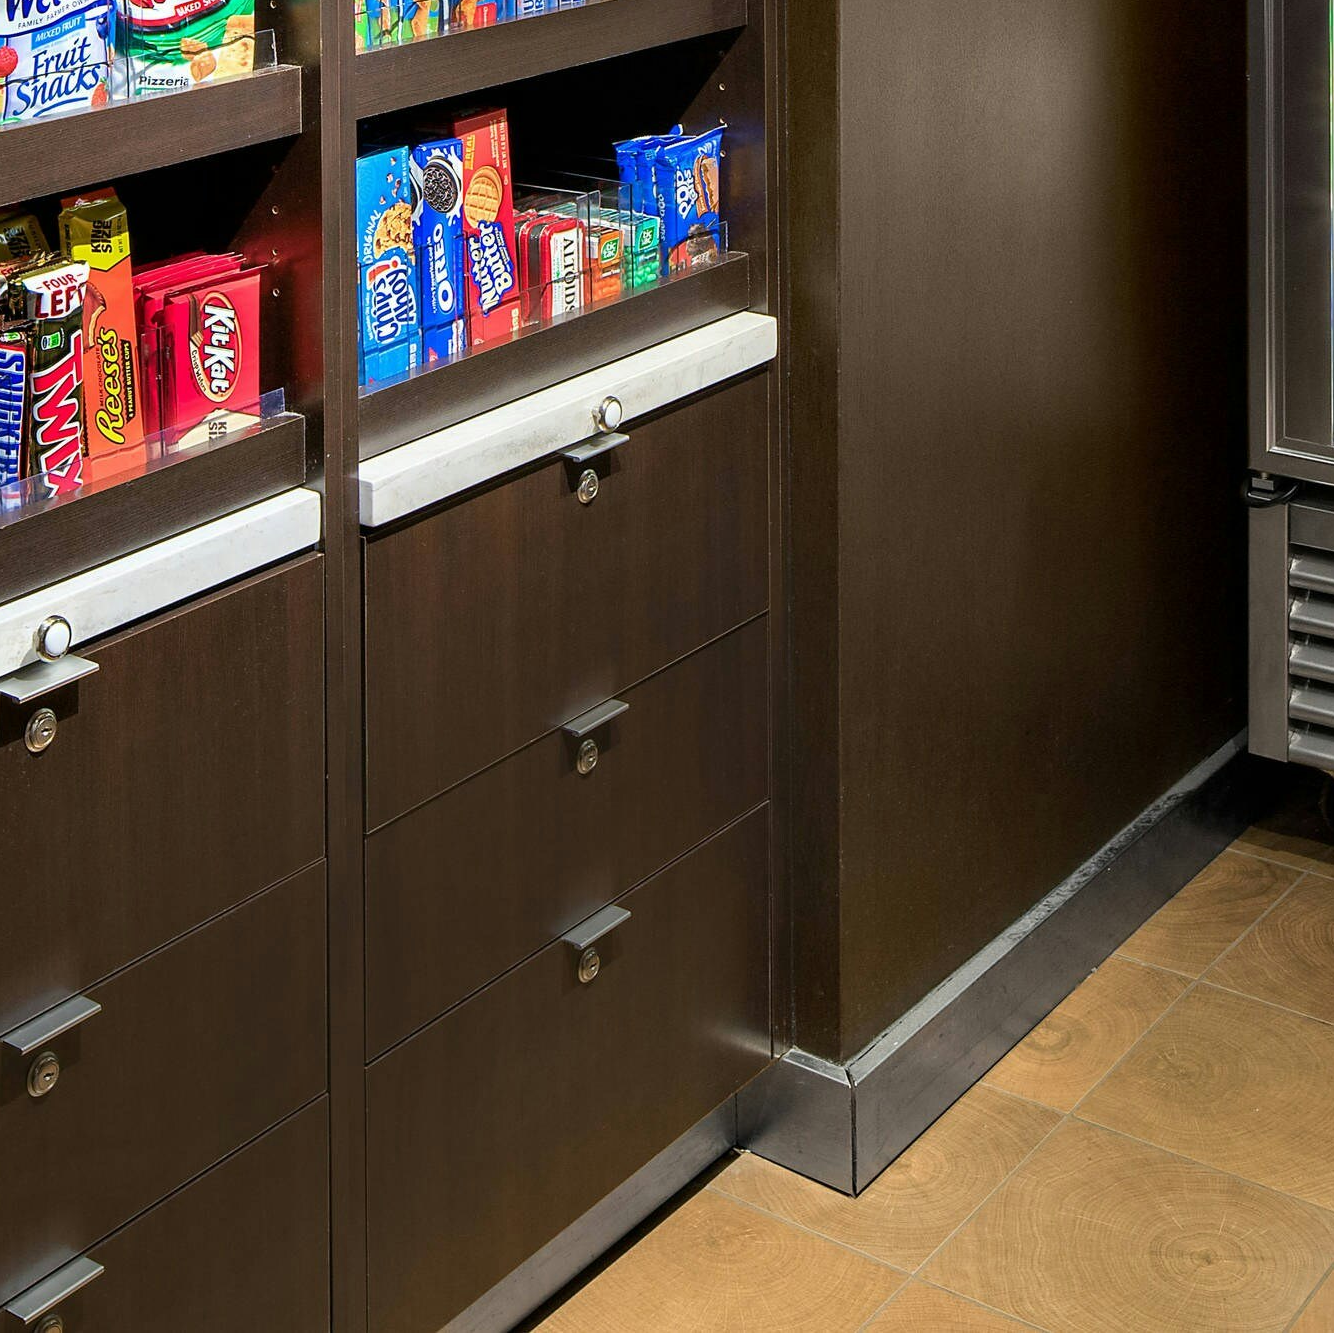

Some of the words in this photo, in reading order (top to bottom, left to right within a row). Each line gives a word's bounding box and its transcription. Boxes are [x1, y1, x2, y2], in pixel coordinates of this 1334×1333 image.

[17, 17, 44, 31] FAMILY
[35, 26, 61, 43] MIXED
[32, 36, 91, 79] Fruit
[13, 62, 100, 117] Snacks
[138, 75, 189, 87] Pizzeria
[101, 219, 113, 254] SIZE
[362, 209, 382, 263] ORIGINAL
[43, 273, 76, 291] FOUR
[433, 223, 455, 314] OREO
[563, 237, 576, 314] ALTOIDS
[95, 327, 126, 445] Reese's
